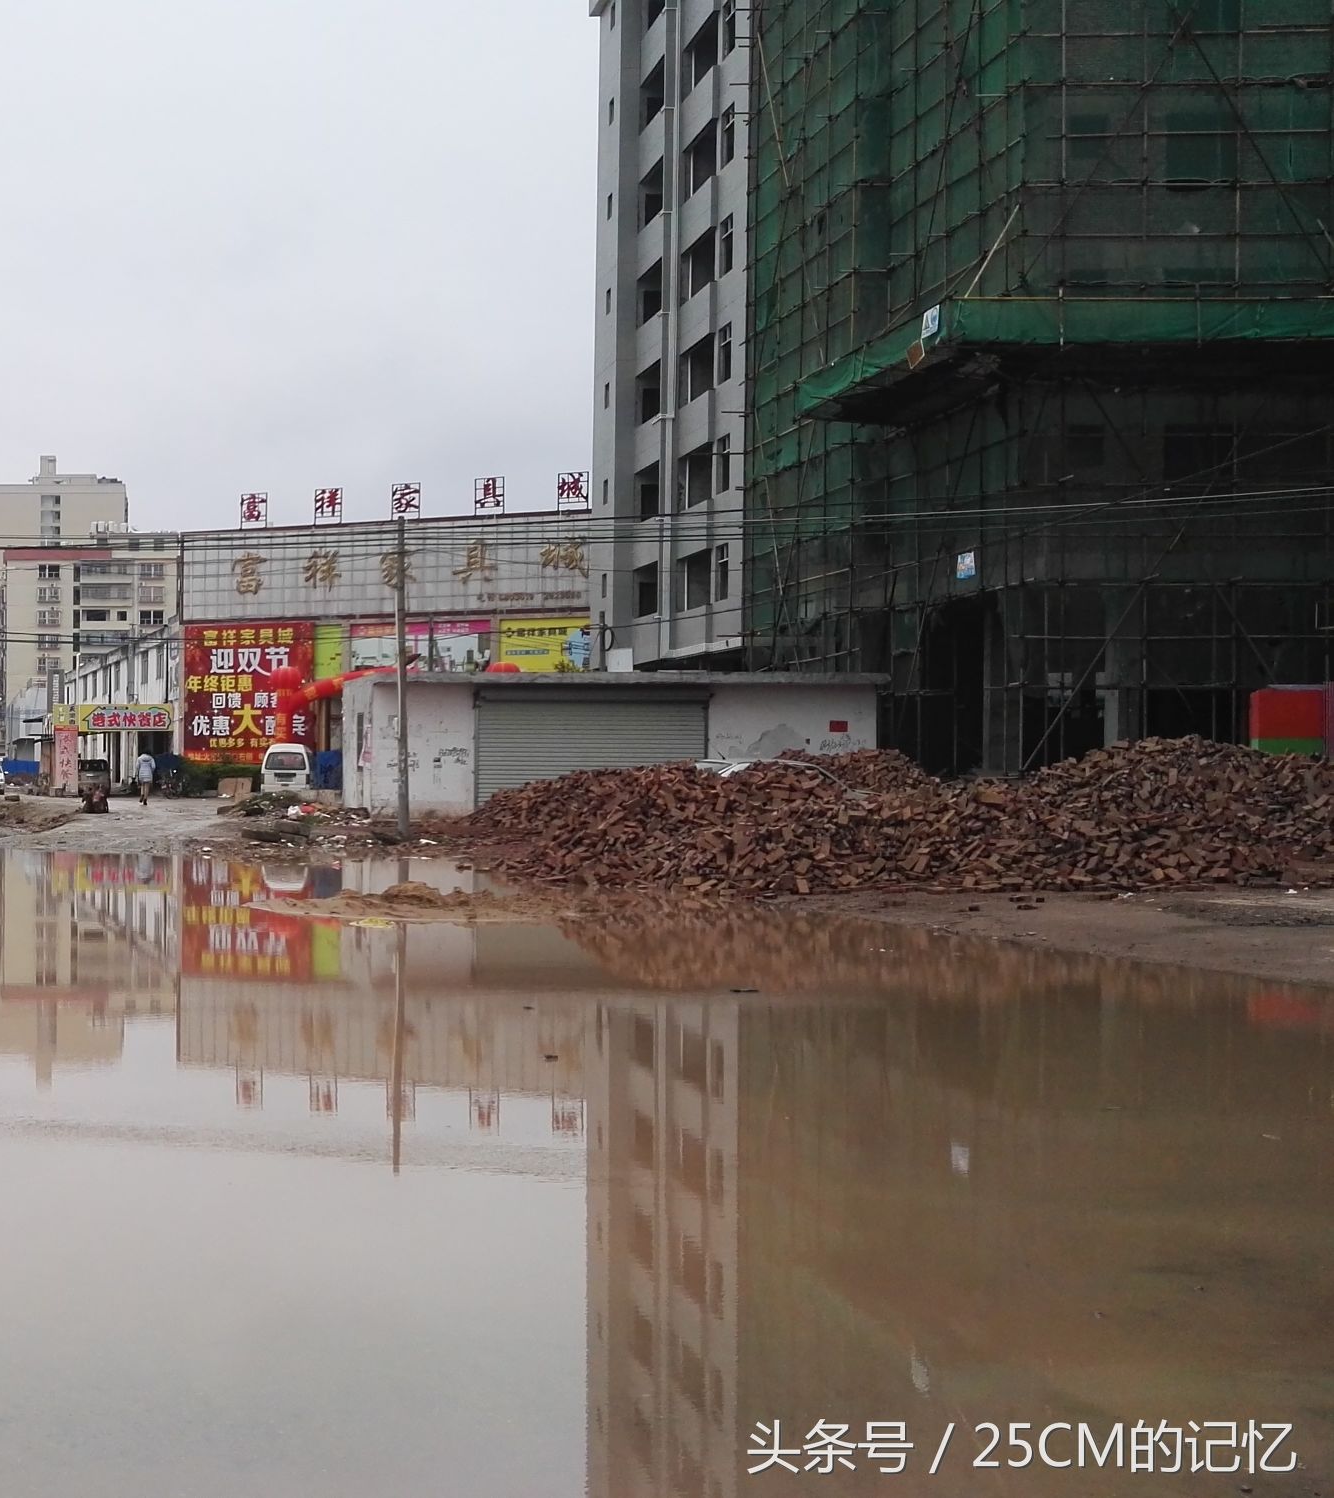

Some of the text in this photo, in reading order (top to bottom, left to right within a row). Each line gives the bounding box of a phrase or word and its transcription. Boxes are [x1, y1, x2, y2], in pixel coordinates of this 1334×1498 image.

[241, 471, 588, 522] 富祥家具城
[232, 538, 590, 595] 富祥家具城
[203, 628, 294, 647] 富祥家具城
[210, 646, 291, 676] 迎双节
[212, 692, 242, 709] 回馈
